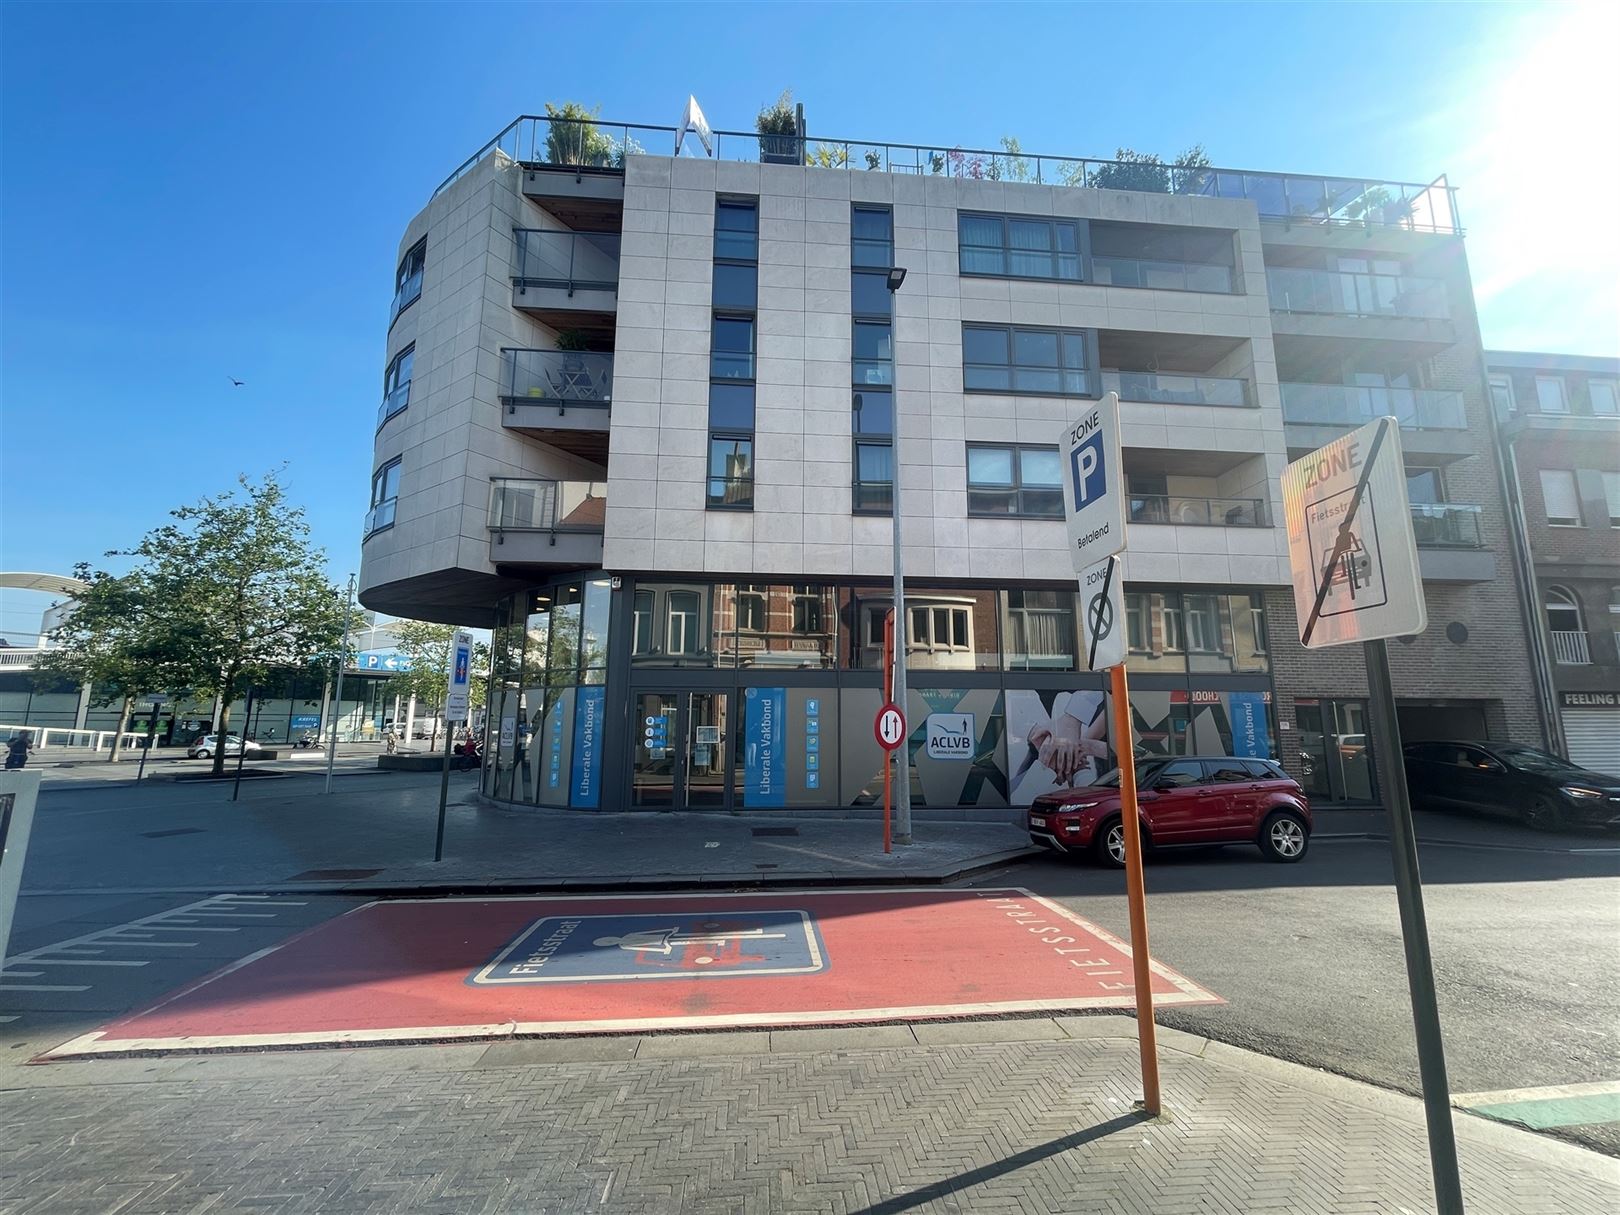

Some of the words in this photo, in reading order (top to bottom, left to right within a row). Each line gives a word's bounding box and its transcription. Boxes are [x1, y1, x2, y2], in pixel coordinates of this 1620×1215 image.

[1071, 411, 1100, 445] ZONE
[1077, 445, 1098, 502] P
[1303, 442, 1362, 489] ZONE
[1311, 496, 1367, 524] Fietsstrt
[1077, 522, 1110, 549] Betalend
[1087, 567, 1107, 586] ZONE
[1565, 694, 1615, 705] FEELING
[583, 699, 595, 748] Vakbond
[761, 699, 772, 748] Vakbond
[931, 736, 970, 749] ACLVB
[1243, 702, 1256, 747] Vakbond
[580, 752, 592, 796] Liberale
[760, 751, 771, 795] Liberale
[508, 920, 582, 974] Fietsstraat
[976, 892, 1136, 990] FIETSSTRAAT
